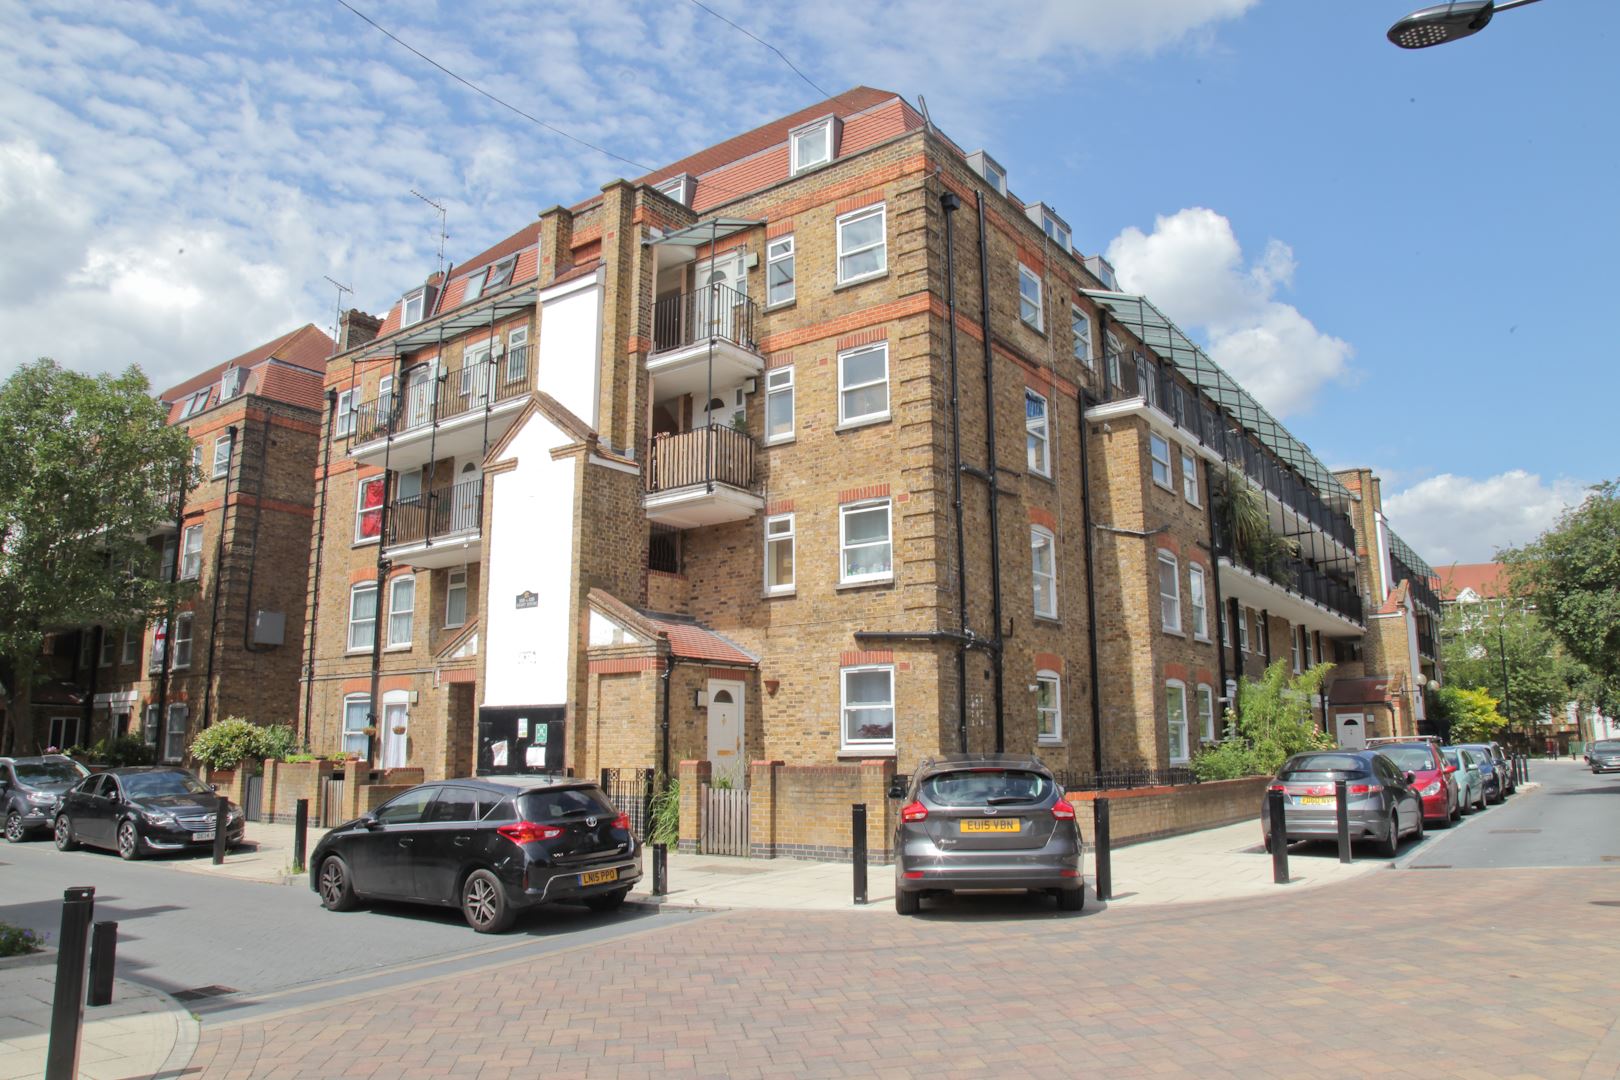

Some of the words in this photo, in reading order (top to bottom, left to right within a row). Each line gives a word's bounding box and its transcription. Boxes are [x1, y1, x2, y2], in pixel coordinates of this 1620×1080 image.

[967, 820, 990, 830] EU15
[993, 820, 1013, 830] VBN
[583, 872, 600, 884] LN15
[600, 869, 615, 881] PPO
